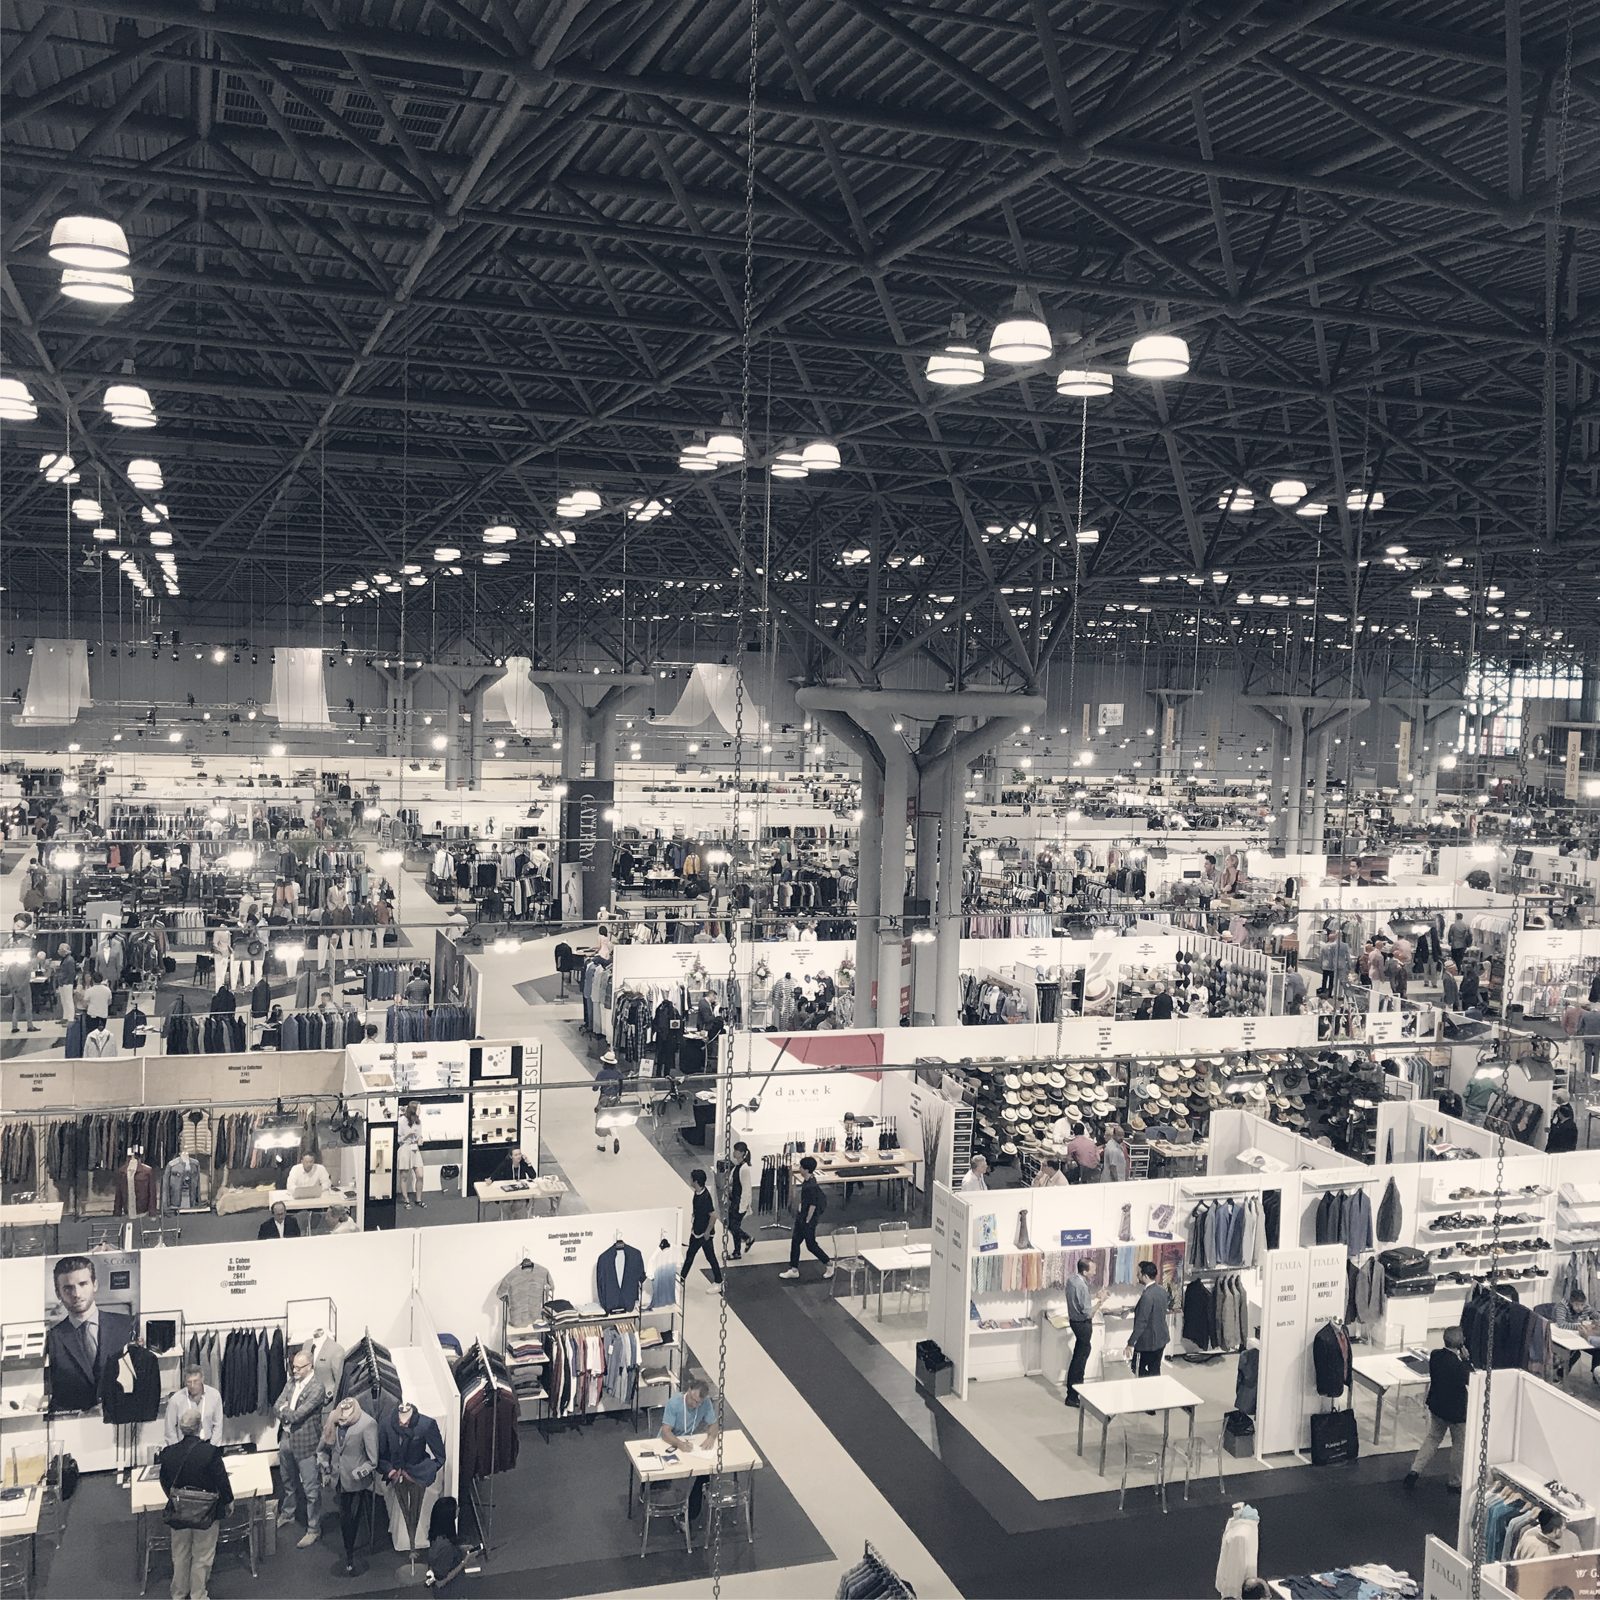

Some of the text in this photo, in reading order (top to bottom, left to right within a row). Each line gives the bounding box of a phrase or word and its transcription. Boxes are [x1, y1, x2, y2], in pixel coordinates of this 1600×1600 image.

[775, 1085, 831, 1096] davek
[524, 1101, 537, 1132] JAN
[235, 1256, 250, 1264] Cohen
[1314, 1257, 1340, 1267] ITALIA
[1275, 1261, 1302, 1270] ITALIA
[1280, 1284, 1295, 1293] SILVIO
[1331, 1280, 1339, 1288] BAY
[1317, 1290, 1333, 1299] NAPOLI
[1431, 1559, 1462, 1591] ITALIA
